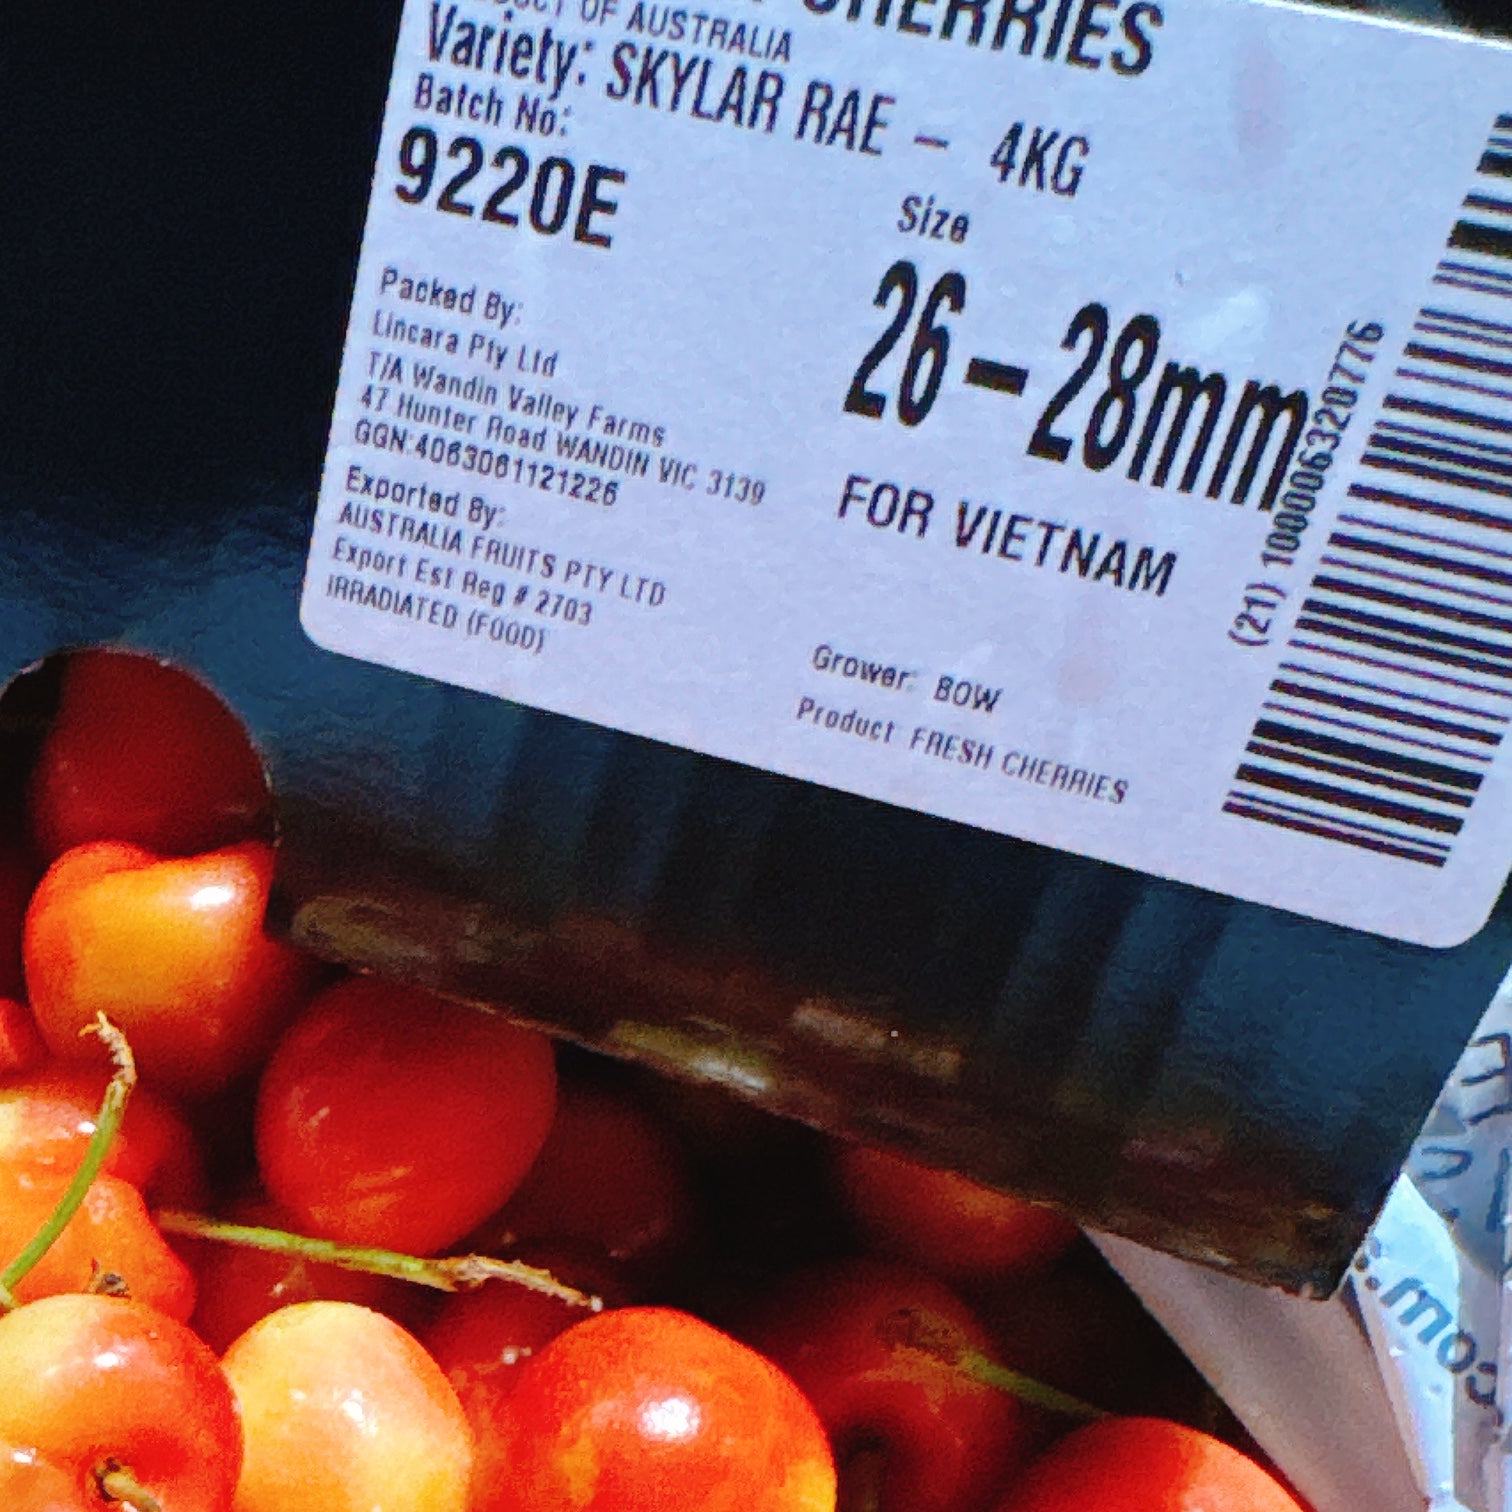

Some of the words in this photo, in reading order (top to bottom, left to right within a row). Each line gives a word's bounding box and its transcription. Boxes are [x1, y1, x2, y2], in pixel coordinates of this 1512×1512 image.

[626, 3, 792, 63] AUSTRALIA
[804, 0, 1164, 75] RRIES
[413, 72, 504, 127] Batch
[514, 92, 573, 137] No:
[429, 2, 594, 101] Variety:
[606, 41, 785, 134] SKYLAR
[795, 79, 896, 156] RAE
[990, 121, 1090, 198] 4KG
[395, 125, 627, 249] 9220E
[897, 195, 970, 244] Size
[380, 266, 477, 313] Packed
[484, 291, 524, 330] By:
[372, 309, 459, 354] Lincara
[469, 333, 508, 370] Pty
[518, 345, 559, 378] Ltd
[368, 350, 402, 384] T/A
[413, 362, 498, 406] Wandin
[509, 384, 579, 430] Valley
[586, 404, 666, 447] Farms
[396, 392, 478, 434] Hunter
[486, 415, 547, 452] Road
[556, 431, 650, 477] WANDIN
[658, 456, 698, 490] VIC
[706, 468, 766, 505] 3139
[346, 464, 460, 518] Exported
[468, 496, 506, 531] By:
[838, 474, 935, 539] FOR
[955, 500, 1178, 597] VIETNAM
[333, 536, 408, 578] Export
[415, 557, 454, 589] Est
[462, 570, 506, 607] Reg
[535, 589, 593, 626] 2703
[338, 501, 463, 555] AUSTRALIA
[471, 535, 557, 579] FRUITS
[564, 559, 614, 592] PTY
[620, 573, 667, 607] LTD
[326, 573, 458, 629] IRRADIATED
[466, 608, 545, 655] (FOOD)
[1228, 582, 1286, 647] (21)
[933, 674, 1003, 714] BOW
[909, 726, 994, 770] FRESH
[1000, 750, 1130, 805] CHERRIES
